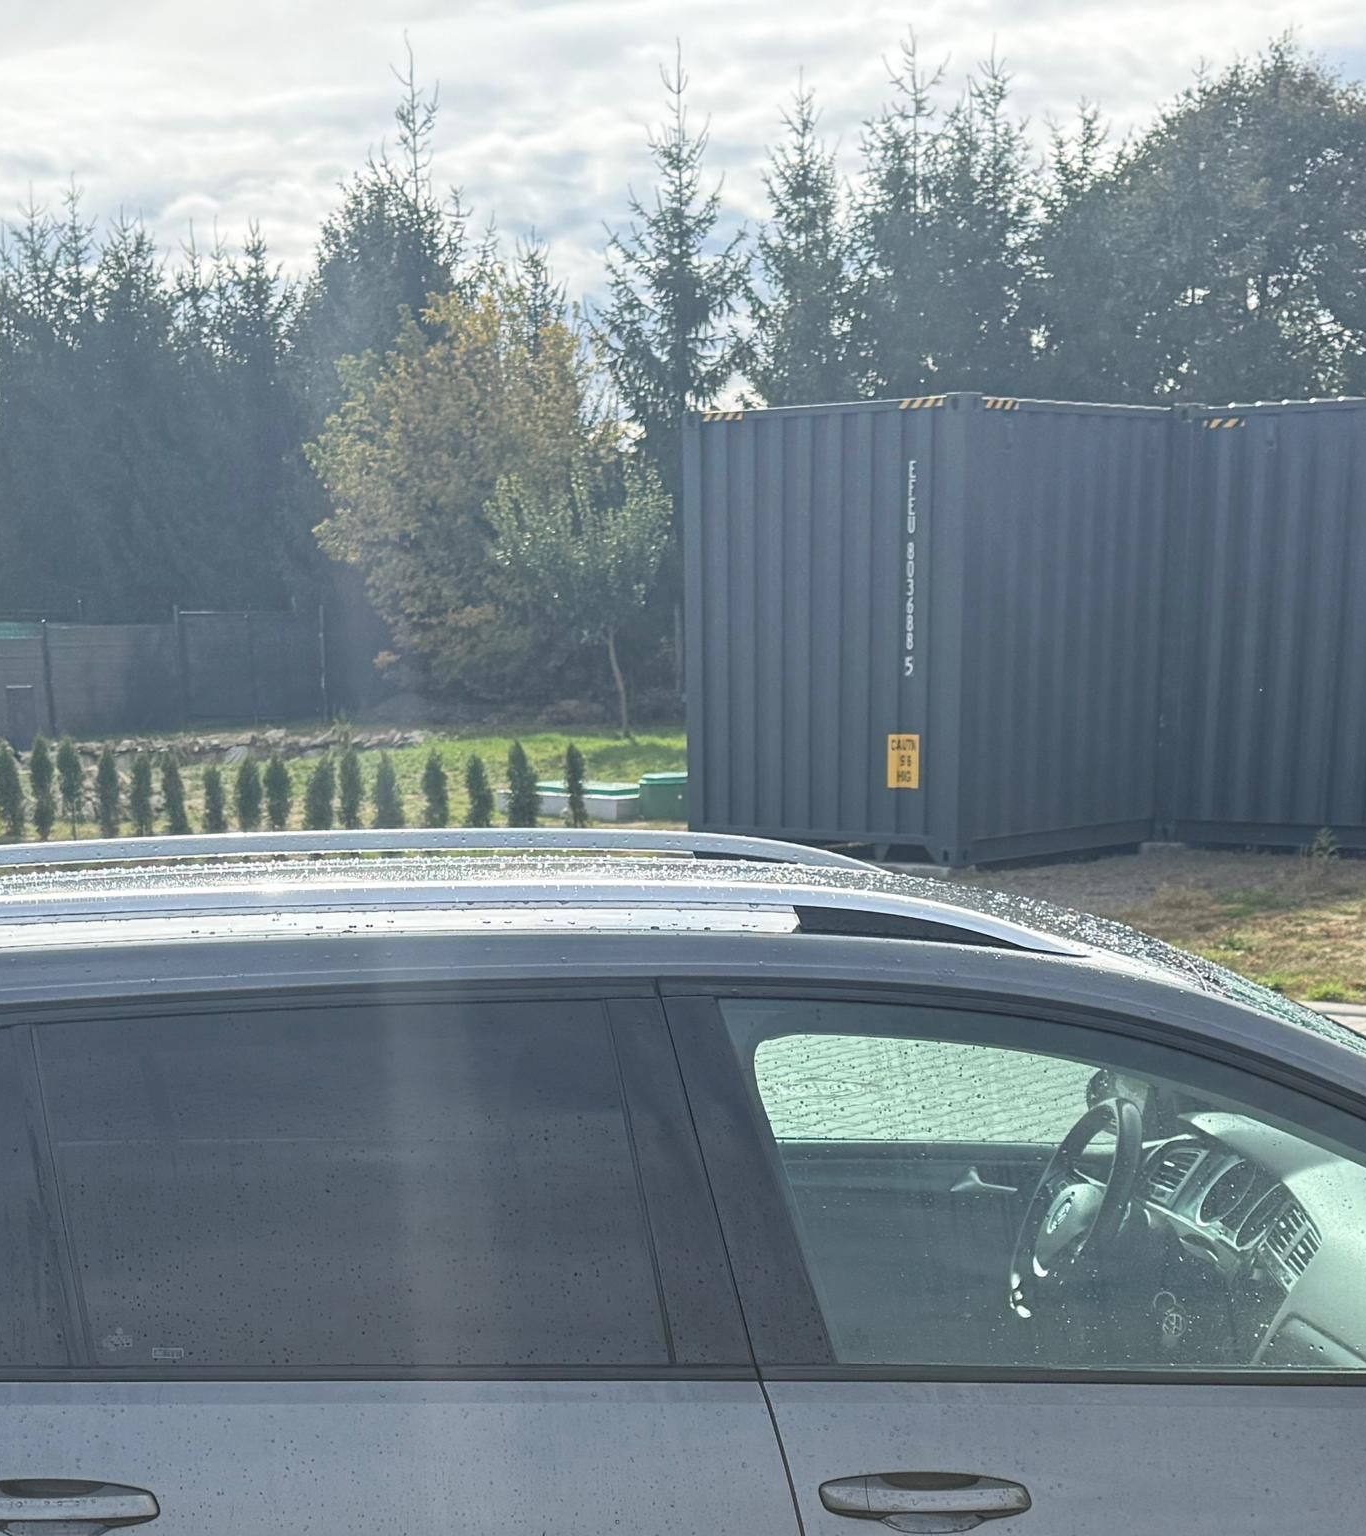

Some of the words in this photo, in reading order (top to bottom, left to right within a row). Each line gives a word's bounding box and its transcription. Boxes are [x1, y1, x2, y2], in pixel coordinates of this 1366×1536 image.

[907, 460, 917, 534] EFEU
[906, 542, 915, 650] 803688
[904, 656, 914, 677] 5
